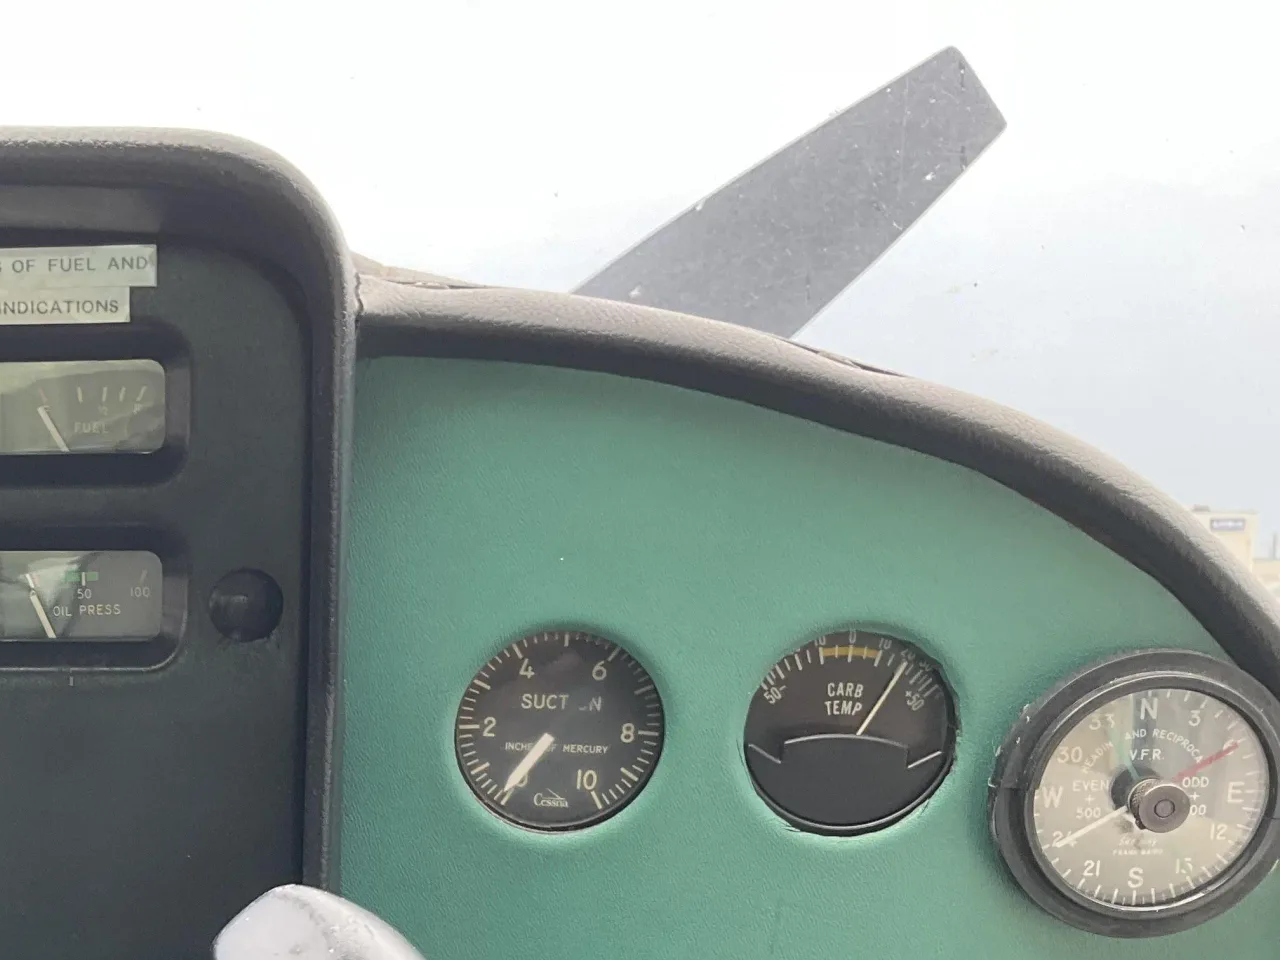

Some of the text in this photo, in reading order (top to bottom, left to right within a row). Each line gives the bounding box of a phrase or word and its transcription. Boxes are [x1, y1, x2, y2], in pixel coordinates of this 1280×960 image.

[12, 259, 36, 274] OF
[48, 257, 96, 272] FUEL
[107, 256, 148, 271] AND
[74, 421, 109, 434] FUEL
[77, 588, 92, 599] 50
[130, 587, 150, 598] 100
[53, 603, 121, 617] OIL PRESS
[519, 658, 535, 678] 4
[592, 660, 607, 681] 6
[828, 682, 864, 698] CARB
[521, 694, 602, 712] SUCTN
[824, 700, 863, 716] TEMP
[1140, 698, 1159, 720] N
[482, 716, 496, 737] 2
[1188, 710, 1201, 727] 3
[620, 722, 635, 744] 8
[1124, 728, 1147, 741] AND
[562, 744, 608, 754] MERCURY
[1057, 746, 1082, 764] 30
[576, 769, 597, 790] 10
[1072, 780, 1110, 792] EVEN
[1182, 777, 1210, 789] ODD
[533, 793, 569, 808] Cessna
[1042, 786, 1063, 808] W
[1227, 781, 1245, 804] E
[1075, 807, 1101, 818] 500
[1209, 824, 1227, 841] 12
[1083, 859, 1101, 877] 21
[1175, 857, 1193, 875] 15
[1127, 867, 1145, 889] S
